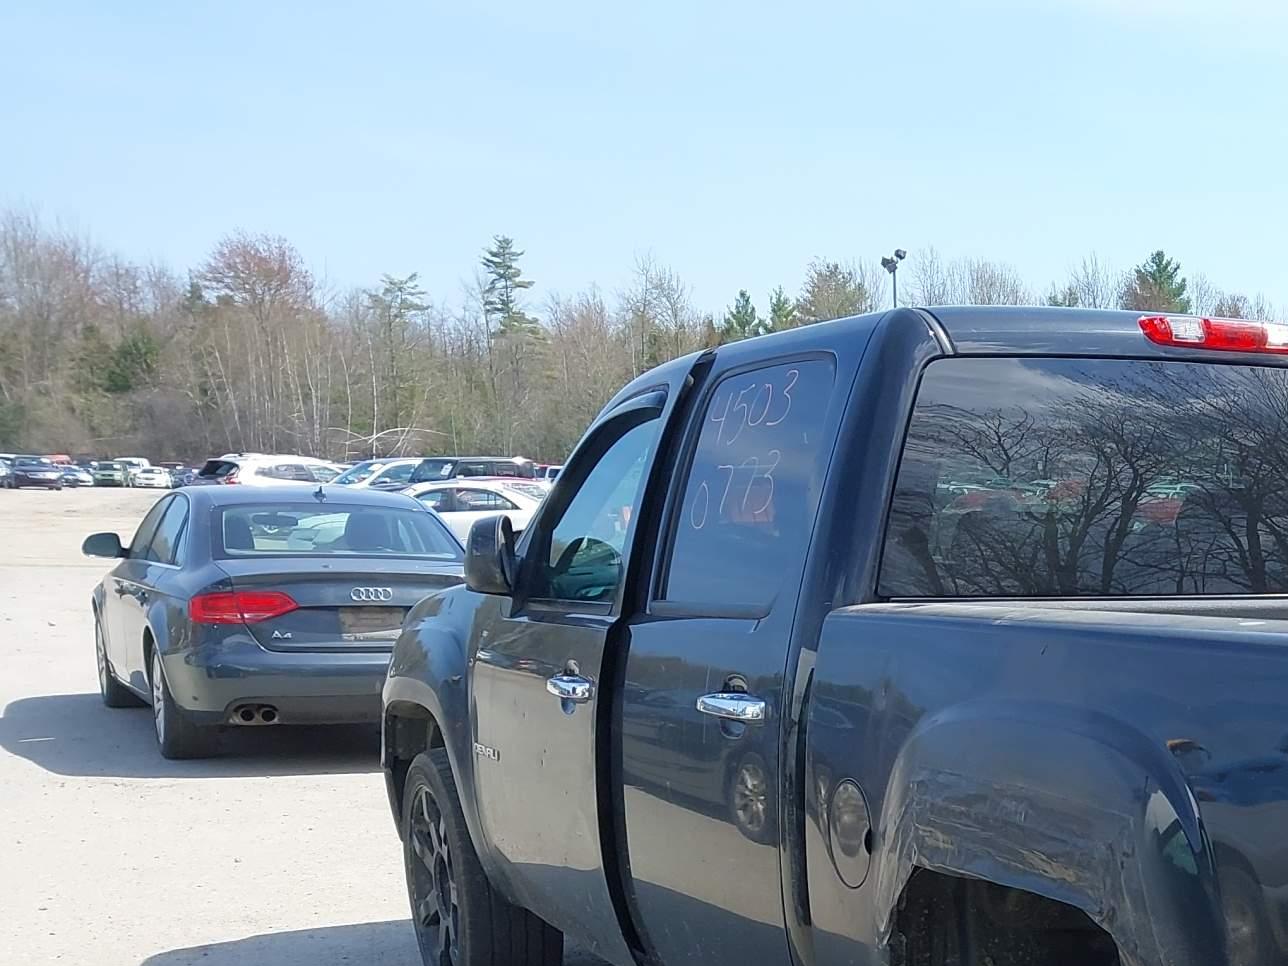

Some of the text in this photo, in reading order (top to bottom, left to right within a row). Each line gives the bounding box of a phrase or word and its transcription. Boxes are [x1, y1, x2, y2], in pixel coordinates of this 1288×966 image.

[711, 369, 799, 446] 4503
[690, 449, 782, 529] 0773
[271, 630, 293, 640] A4
